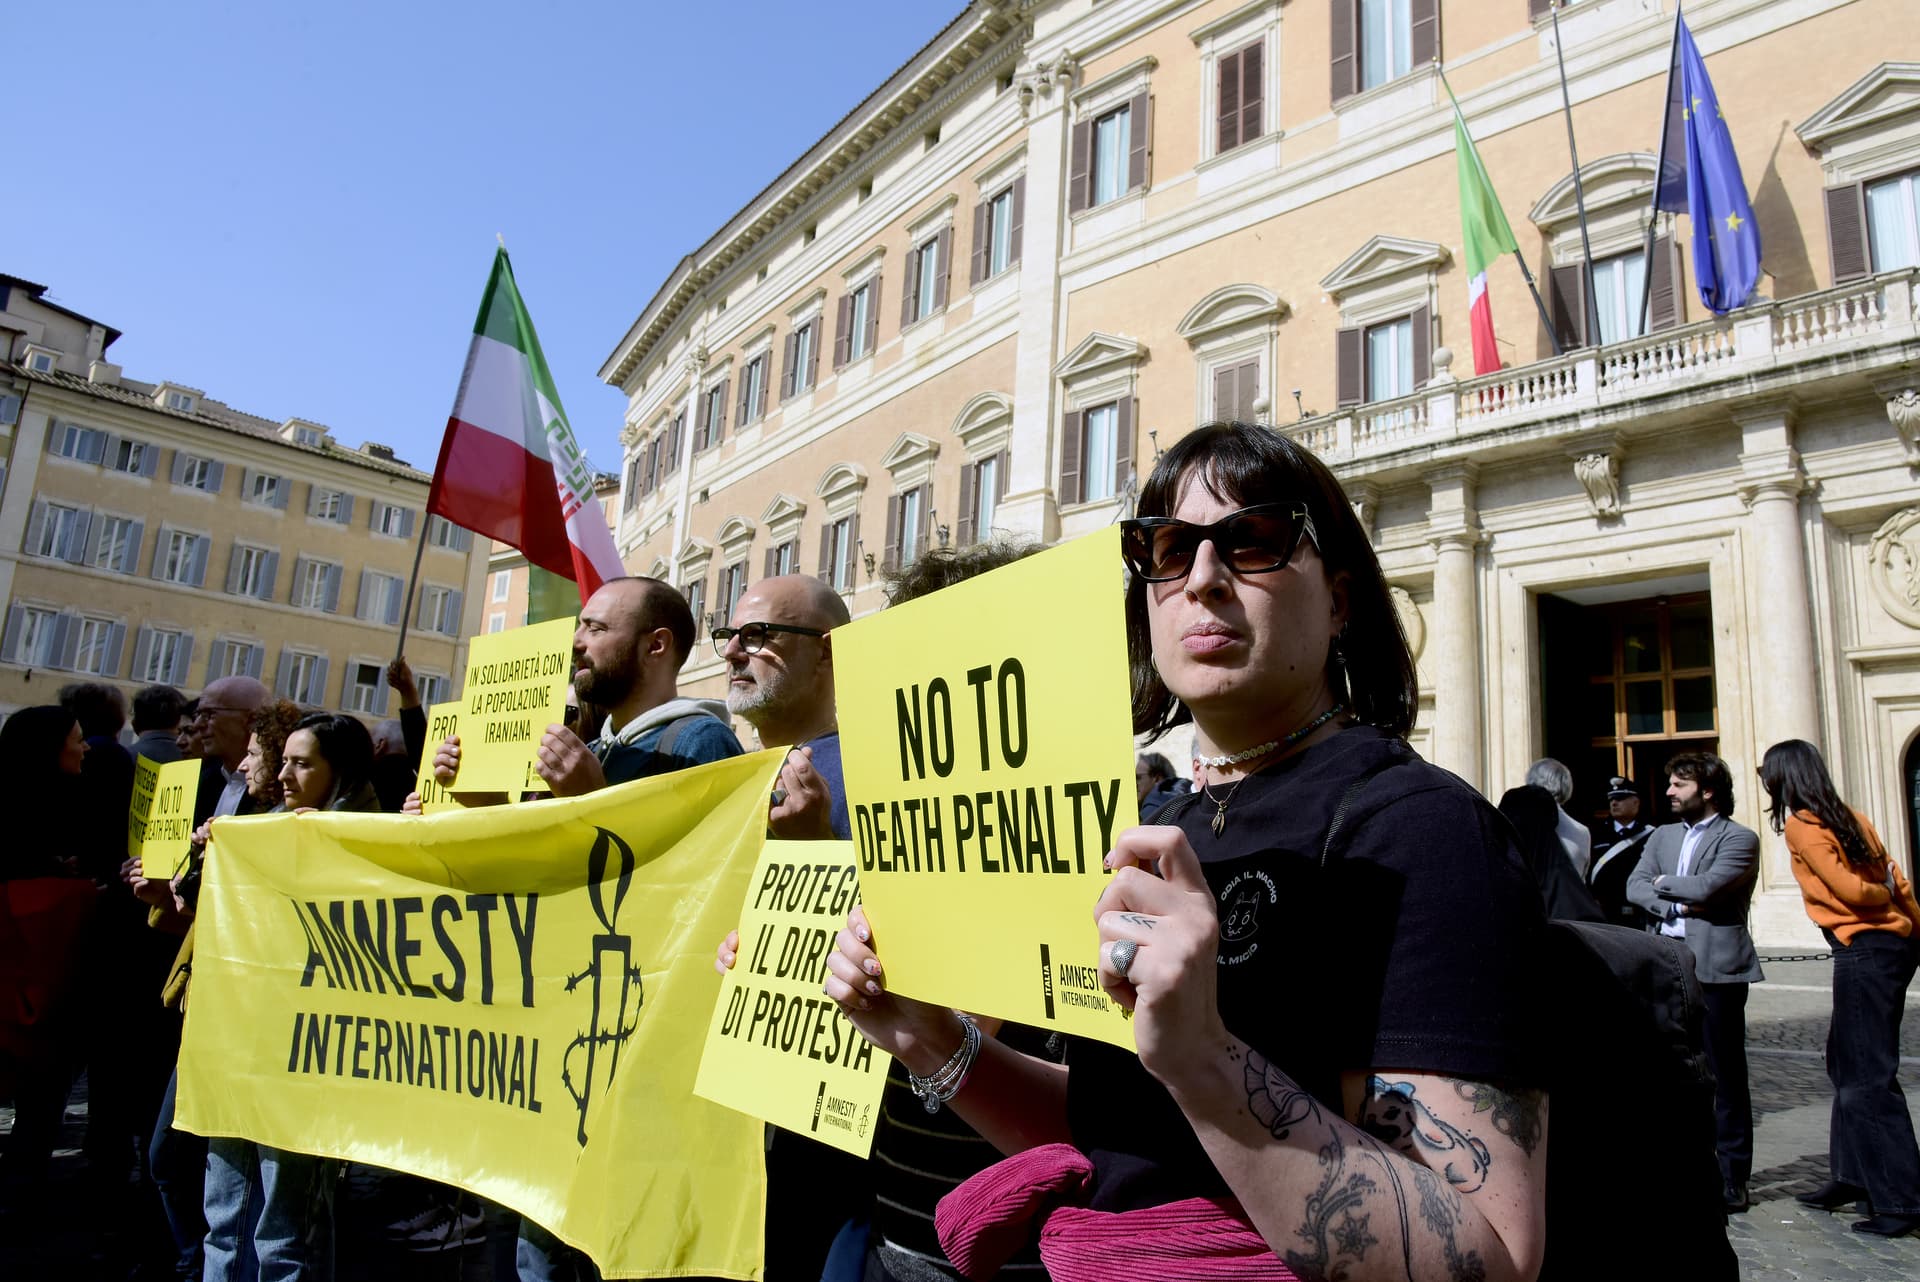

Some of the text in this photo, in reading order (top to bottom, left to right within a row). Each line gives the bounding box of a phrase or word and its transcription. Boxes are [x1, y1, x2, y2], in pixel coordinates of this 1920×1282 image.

[469, 651, 565, 687] IN SOLIDARIETÀ CON
[471, 686, 551, 715] LA POPOLAZIONE
[485, 720, 531, 743] IRANIANA
[895, 657, 1028, 782] NO TO
[158, 785, 182, 814] NO TO
[164, 819, 191, 841] PENALTY
[855, 778, 1121, 875] DEATH PENALTY
[1221, 870, 1278, 904] ODIA IL MACHO
[290, 892, 539, 1008] AMNESTY
[750, 923, 776, 975] IL
[1216, 943, 1258, 965] IL MICIO
[1043, 965, 1053, 997] ITALIA
[1061, 991, 1110, 1012] INTERNATIONAL
[720, 985, 874, 1073] DI PROTESTA
[288, 1012, 542, 1114] INTERNATIONAL
[826, 1096, 858, 1119] AMNESTY
